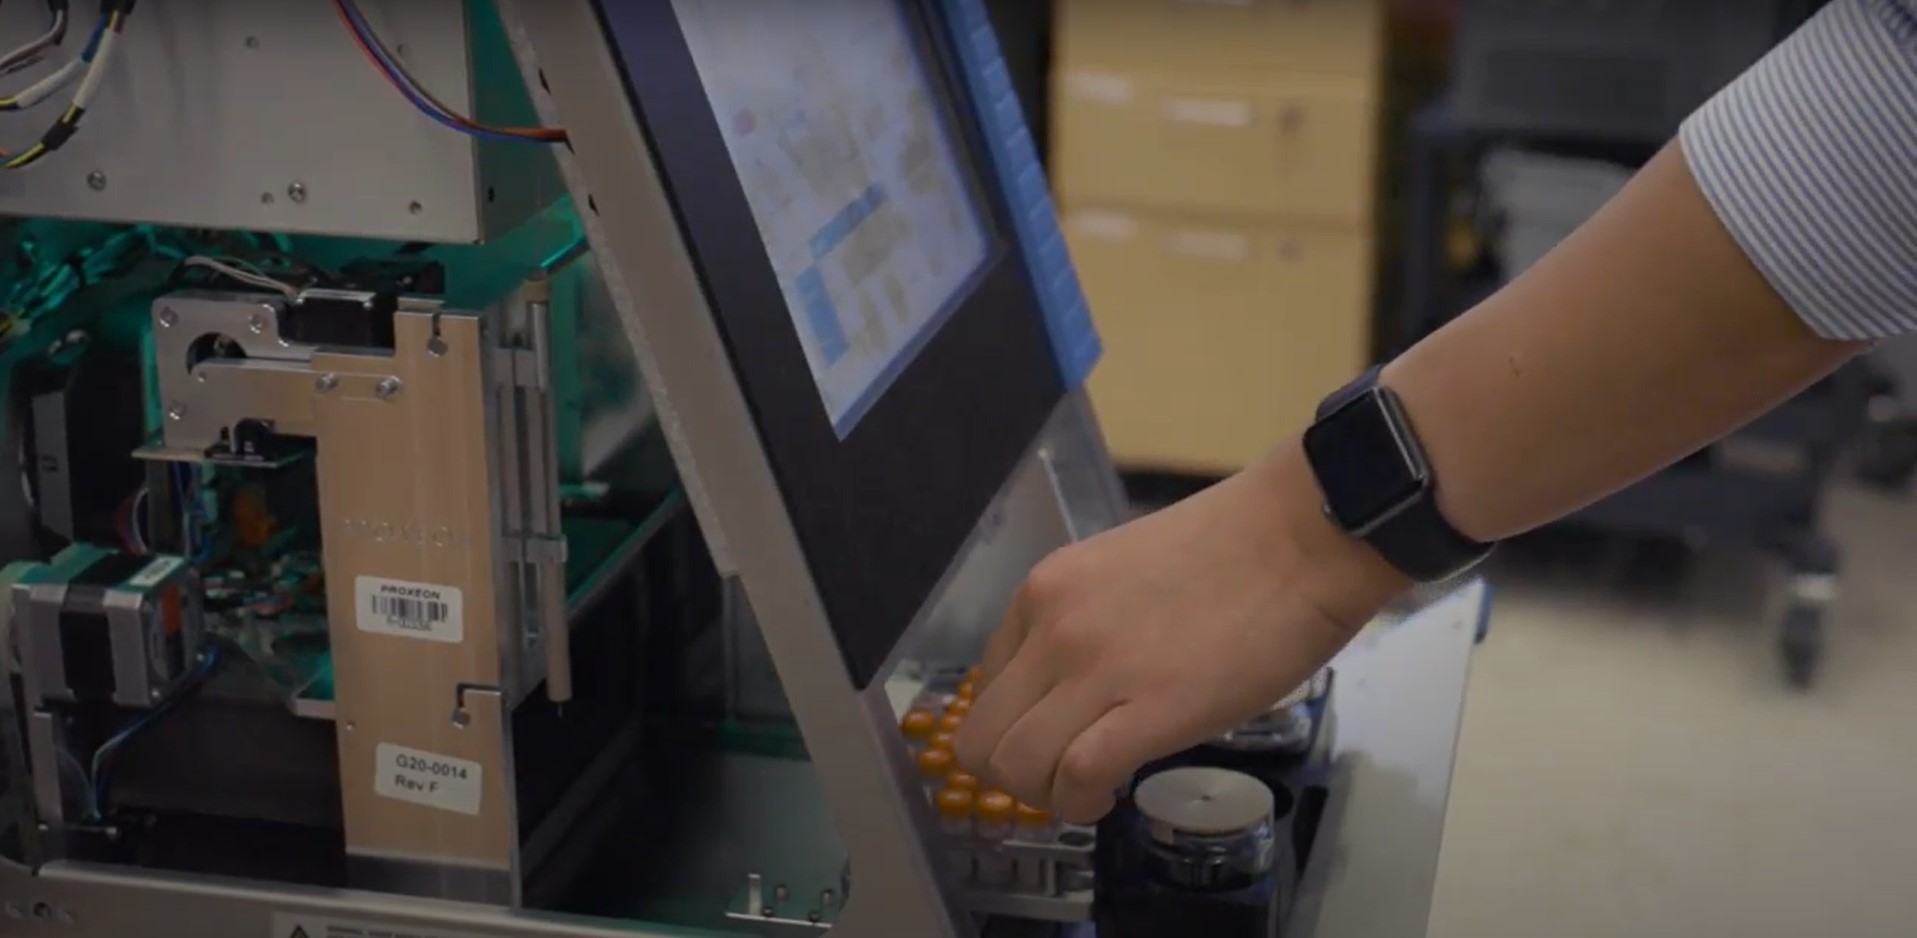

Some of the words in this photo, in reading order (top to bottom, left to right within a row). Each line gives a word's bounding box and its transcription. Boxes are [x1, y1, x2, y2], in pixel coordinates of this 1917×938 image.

[382, 585, 440, 599] PROXEON
[396, 754, 467, 779] G20-0014
[395, 774, 424, 790] Rev
[429, 780, 439, 792] F
